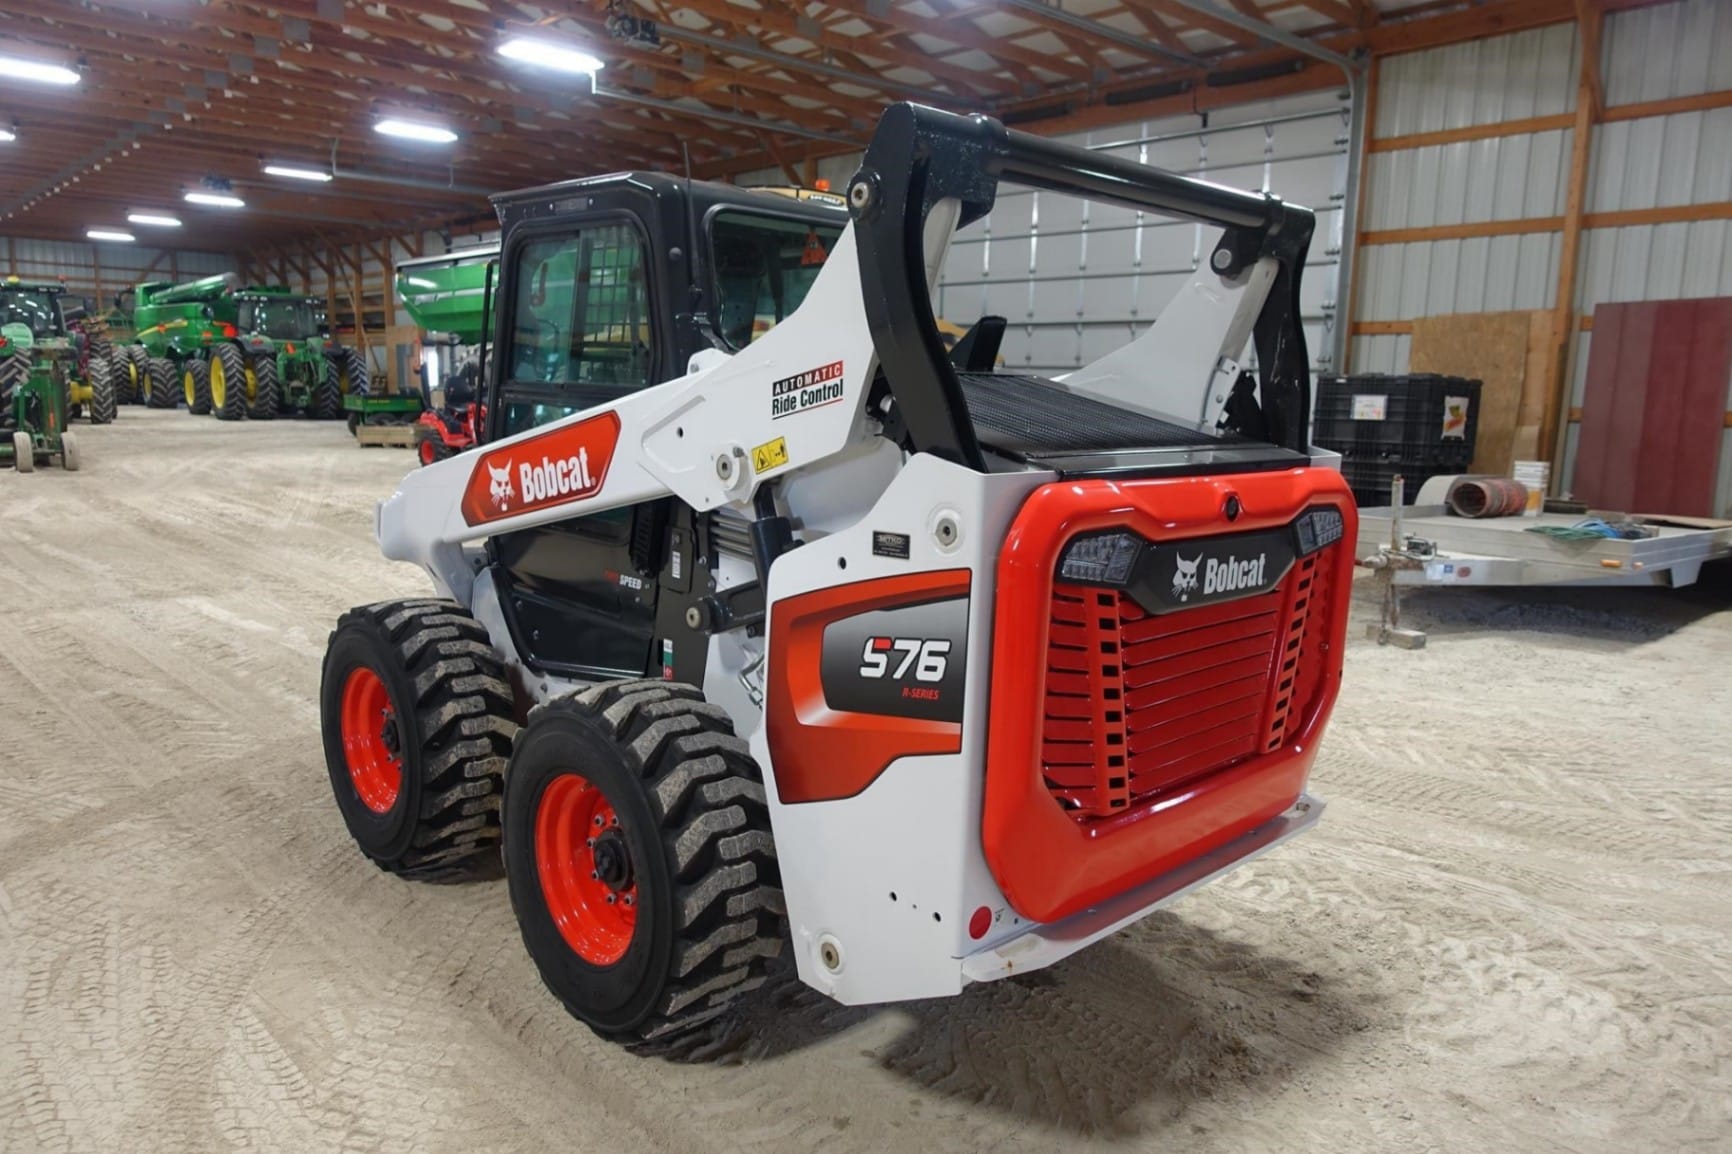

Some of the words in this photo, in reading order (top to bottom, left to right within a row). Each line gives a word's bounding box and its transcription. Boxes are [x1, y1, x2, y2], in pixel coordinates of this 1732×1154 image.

[772, 394, 797, 416] Ride
[800, 378, 843, 408] Control
[774, 363, 842, 396] AUTOMATIC
[519, 446, 591, 504] Bobcat
[1203, 552, 1266, 595] Bobcat
[860, 637, 951, 682] S76
